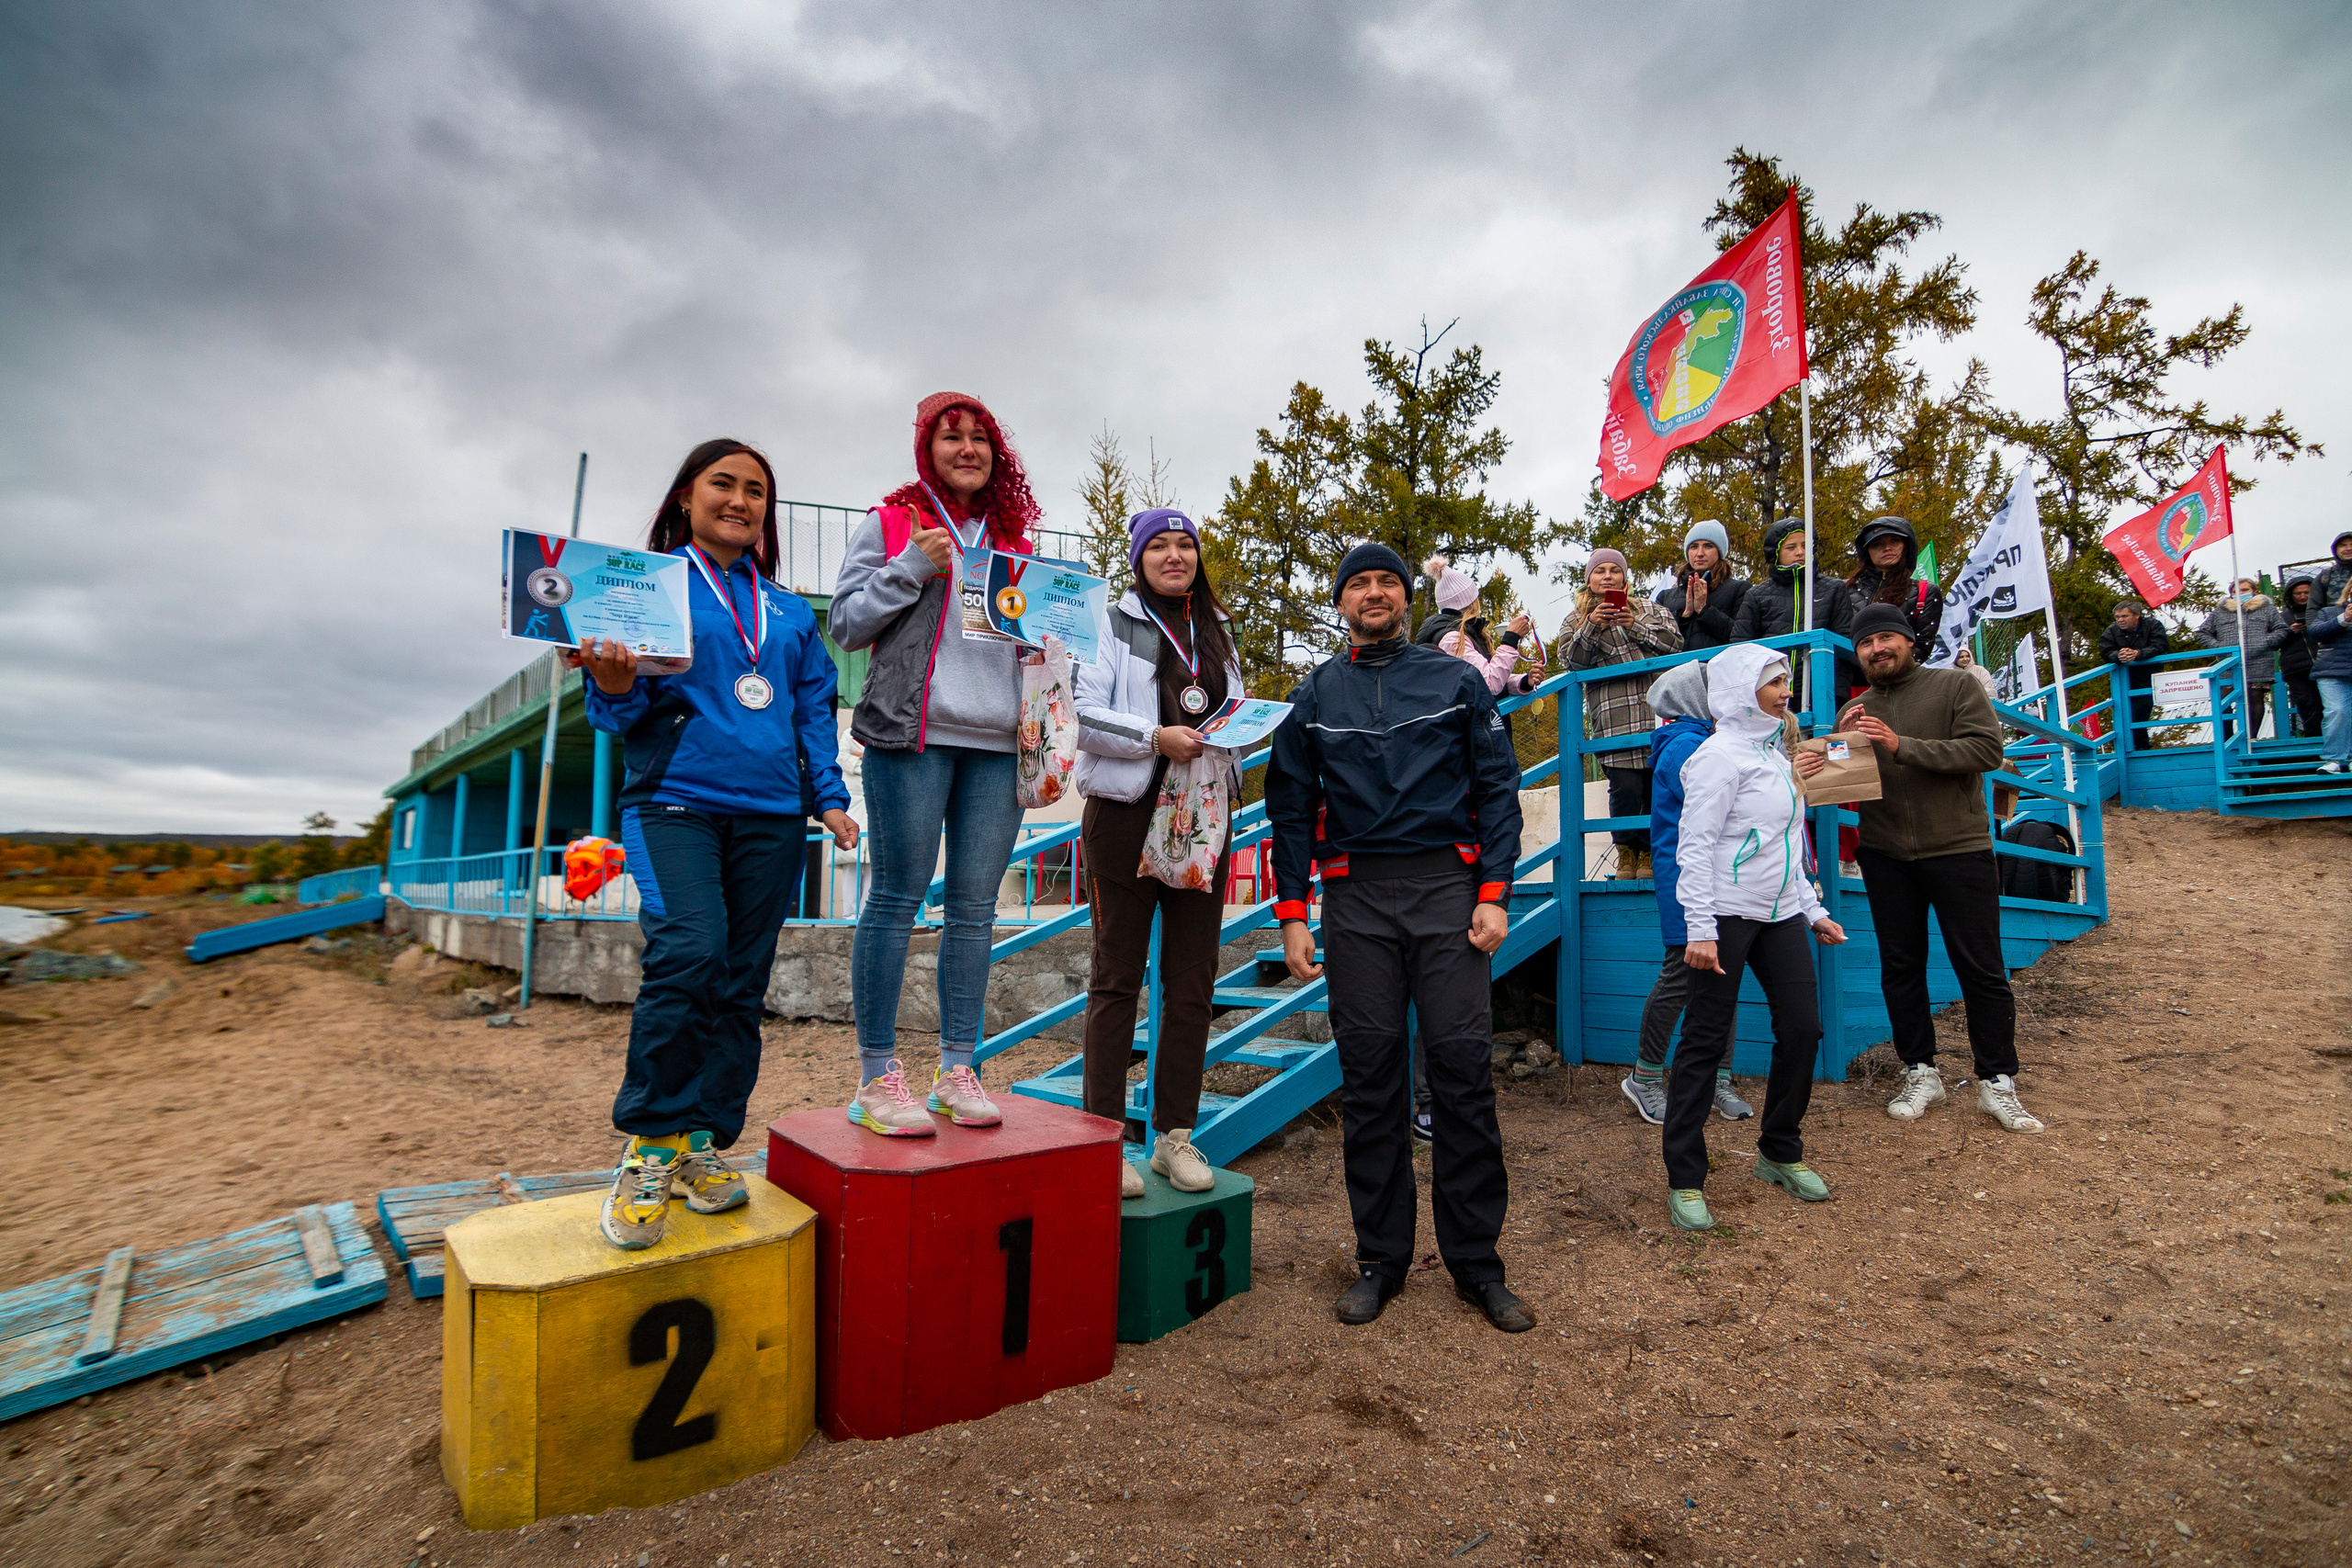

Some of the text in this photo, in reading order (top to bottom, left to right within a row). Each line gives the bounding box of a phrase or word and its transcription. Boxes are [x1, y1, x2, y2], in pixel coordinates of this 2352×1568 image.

[606, 558, 646, 572] SUP RACE
[595, 574, 656, 592] ДИПЛОМ
[970, 571, 987, 581] NO
[543, 578, 559, 596] 2
[1053, 578, 1065, 587] SUP
[1065, 581, 1080, 591] RACE
[964, 592, 984, 607] 50
[1007, 596, 1015, 611] 1
[1043, 592, 1085, 609] ДИПЛОМ
[977, 633, 1012, 642] ПРИКЛЮЧЕНИЙ
[2159, 684, 2204, 694] ЗАПРЕЩЕНО
[1185, 1207, 1227, 1321] 3
[999, 1217, 1034, 1356] 1
[628, 1297, 718, 1462] 2
